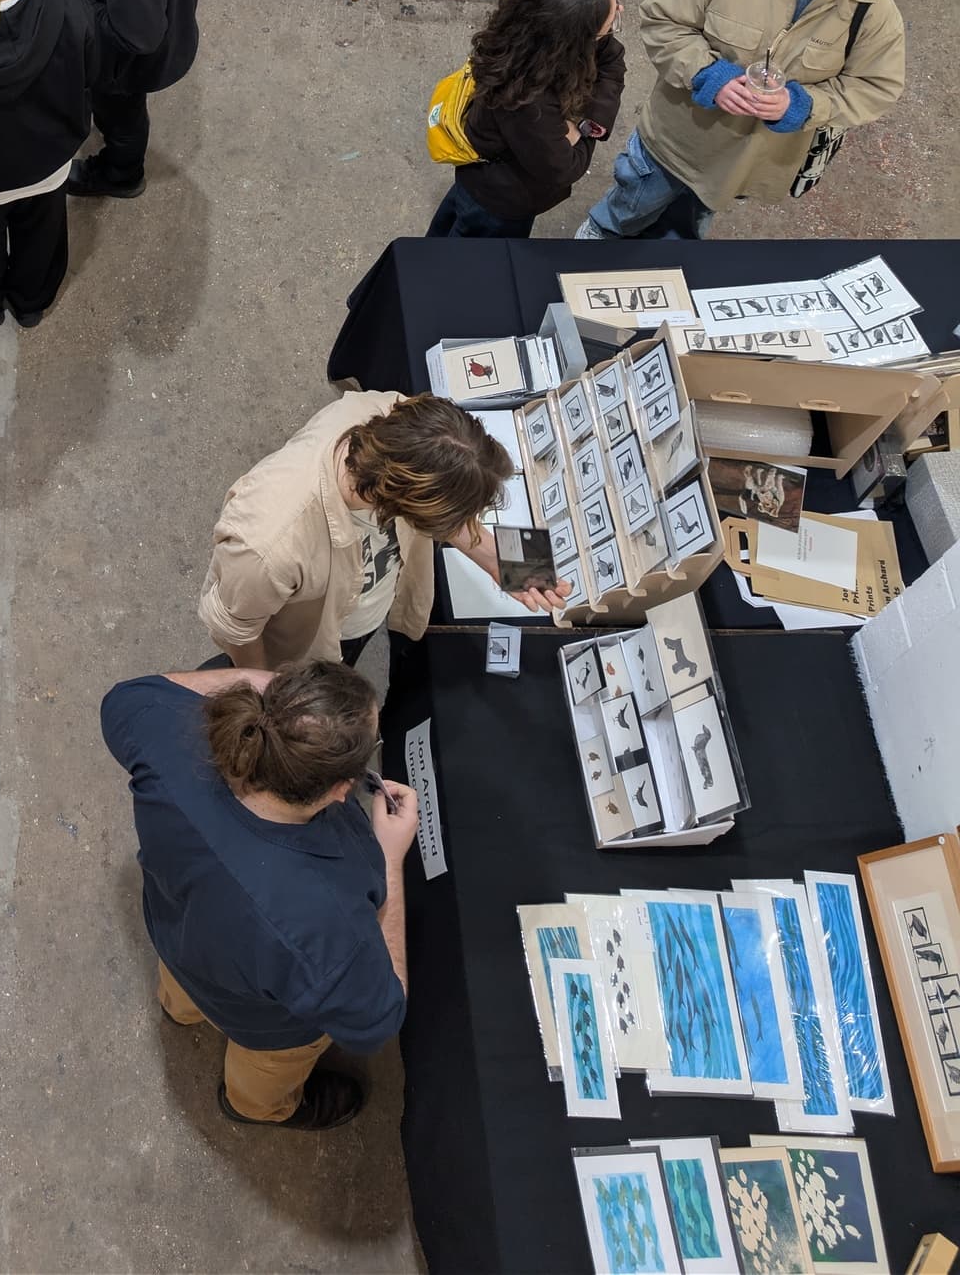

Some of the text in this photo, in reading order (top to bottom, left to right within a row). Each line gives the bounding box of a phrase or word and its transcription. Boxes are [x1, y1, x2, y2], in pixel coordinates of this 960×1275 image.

[865, 586, 875, 612] Prints
[878, 559, 890, 594] Archard
[408, 741, 421, 801] Linoc
[422, 778, 437, 856] Archard
